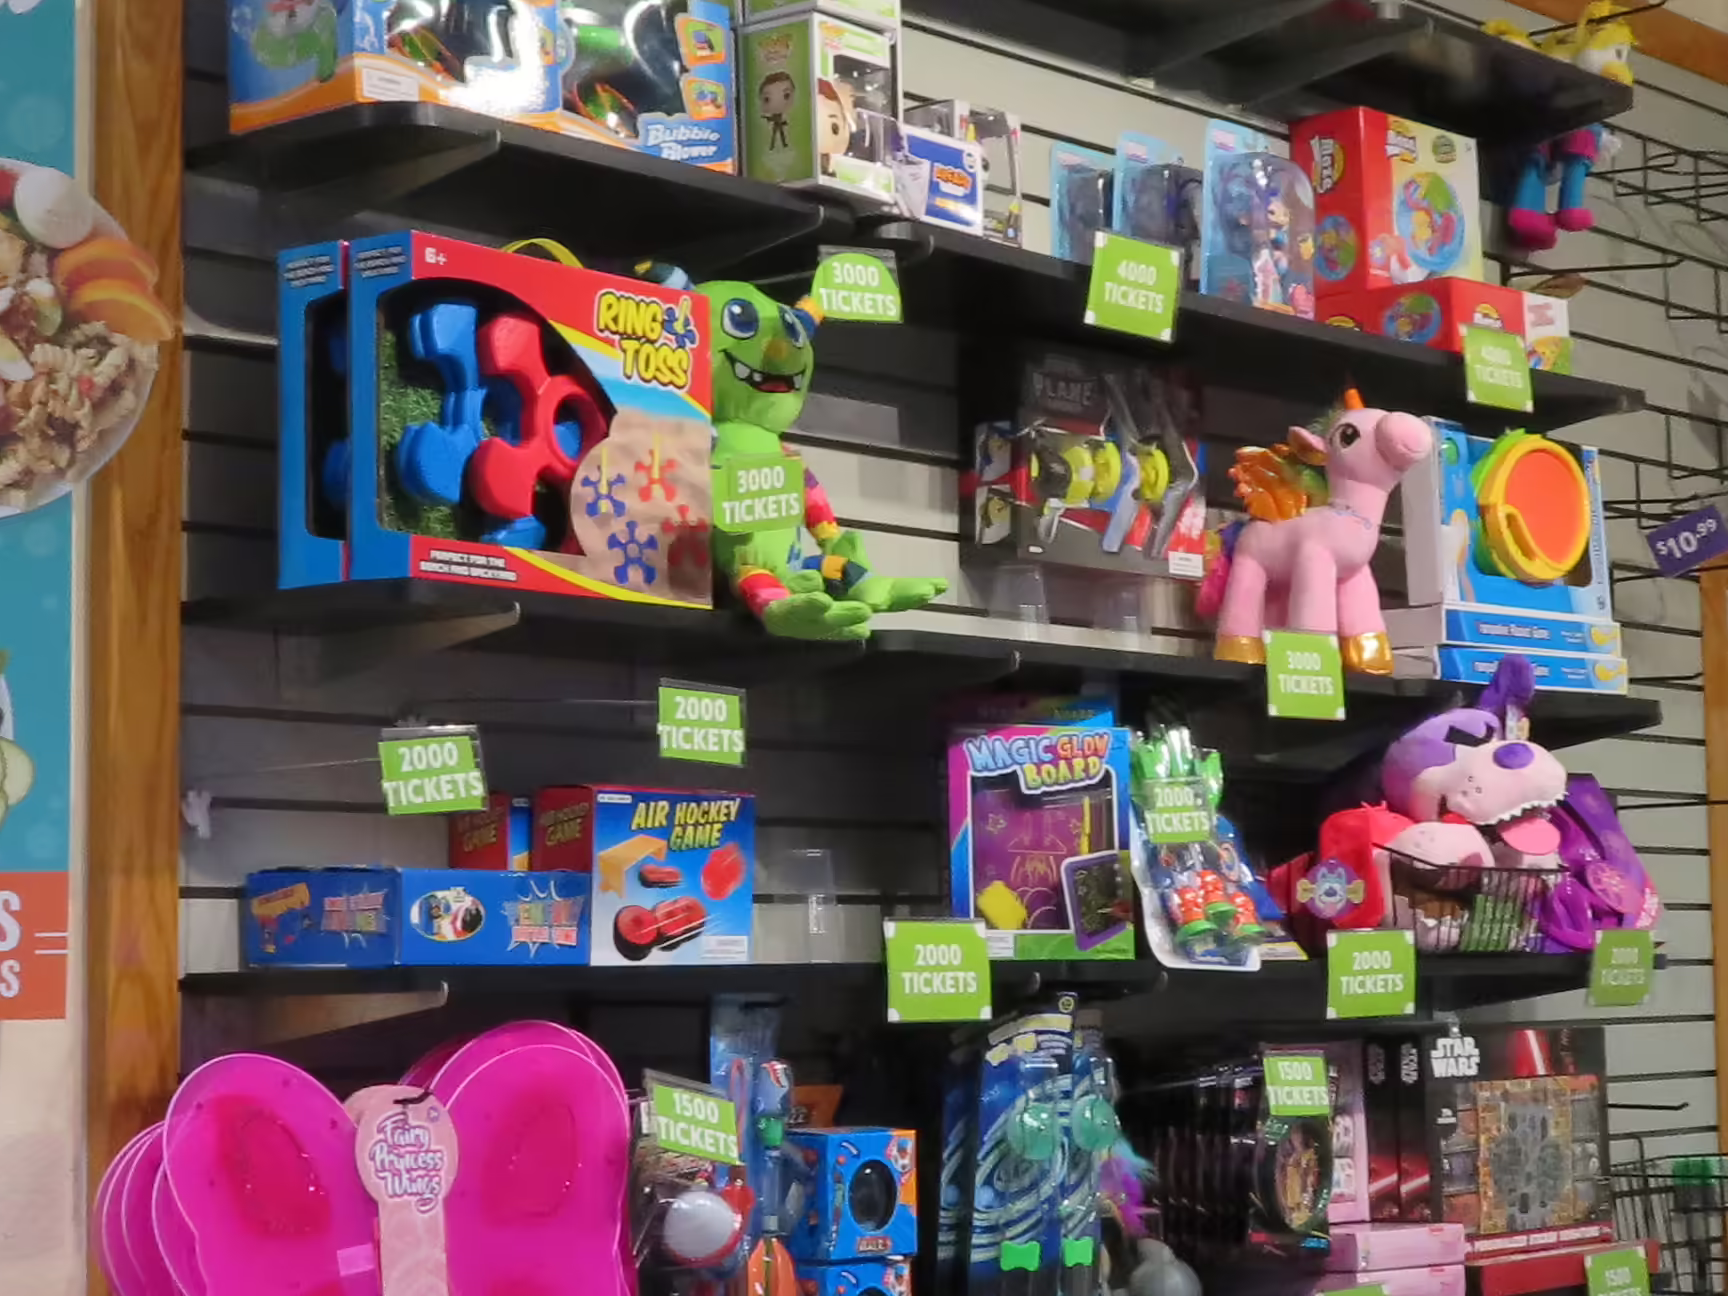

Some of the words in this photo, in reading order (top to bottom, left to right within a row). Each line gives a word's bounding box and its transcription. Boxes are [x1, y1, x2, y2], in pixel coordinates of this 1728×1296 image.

[647, 123, 722, 147] Bubble
[660, 141, 718, 161] Blower
[424, 246, 449, 266] 6+
[832, 260, 880, 288] 3000
[1116, 258, 1158, 287] 4000
[819, 287, 898, 317] TICKETS
[1104, 281, 1165, 315] TICKETS
[595, 290, 665, 343] RING
[619, 338, 691, 389] TOSS
[736, 465, 785, 492] 3000
[722, 491, 800, 524] TICKETS
[1656, 518, 1717, 560] $10.99
[1286, 649, 1322, 672] 3000
[1277, 670, 1334, 698] TICKETS
[674, 695, 728, 723] 2000
[658, 722, 745, 755] TICKETS
[966, 737, 1054, 772] MAGIC
[1056, 734, 1110, 759] GLOW
[397, 740, 459, 774] 2000
[1022, 756, 1102, 789] BOARD
[383, 771, 484, 808] TICKETS
[1153, 785, 1198, 809] 2000
[630, 801, 669, 832] AIR
[673, 797, 741, 830] HOCKEY
[1147, 807, 1210, 838] TICKETS
[668, 822, 723, 852] GAME
[913, 942, 962, 967] 2000
[1352, 948, 1393, 973] 2000
[901, 968, 979, 996] TICKETS
[1338, 969, 1406, 998] TICKETS
[1599, 964, 1646, 987] TICKETS
[1432, 1035, 1480, 1059] STAR
[1278, 1058, 1313, 1082] 1500
[1430, 1055, 1481, 1079] WARS
[671, 1090, 720, 1125] 1500
[1268, 1081, 1330, 1109] TICKETS
[377, 1113, 430, 1152] Fairy
[656, 1116, 739, 1160] TICKETS
[373, 1140, 443, 1172] Princess
[376, 1169, 440, 1212] Wings
[1604, 1266, 1631, 1287] 1500
